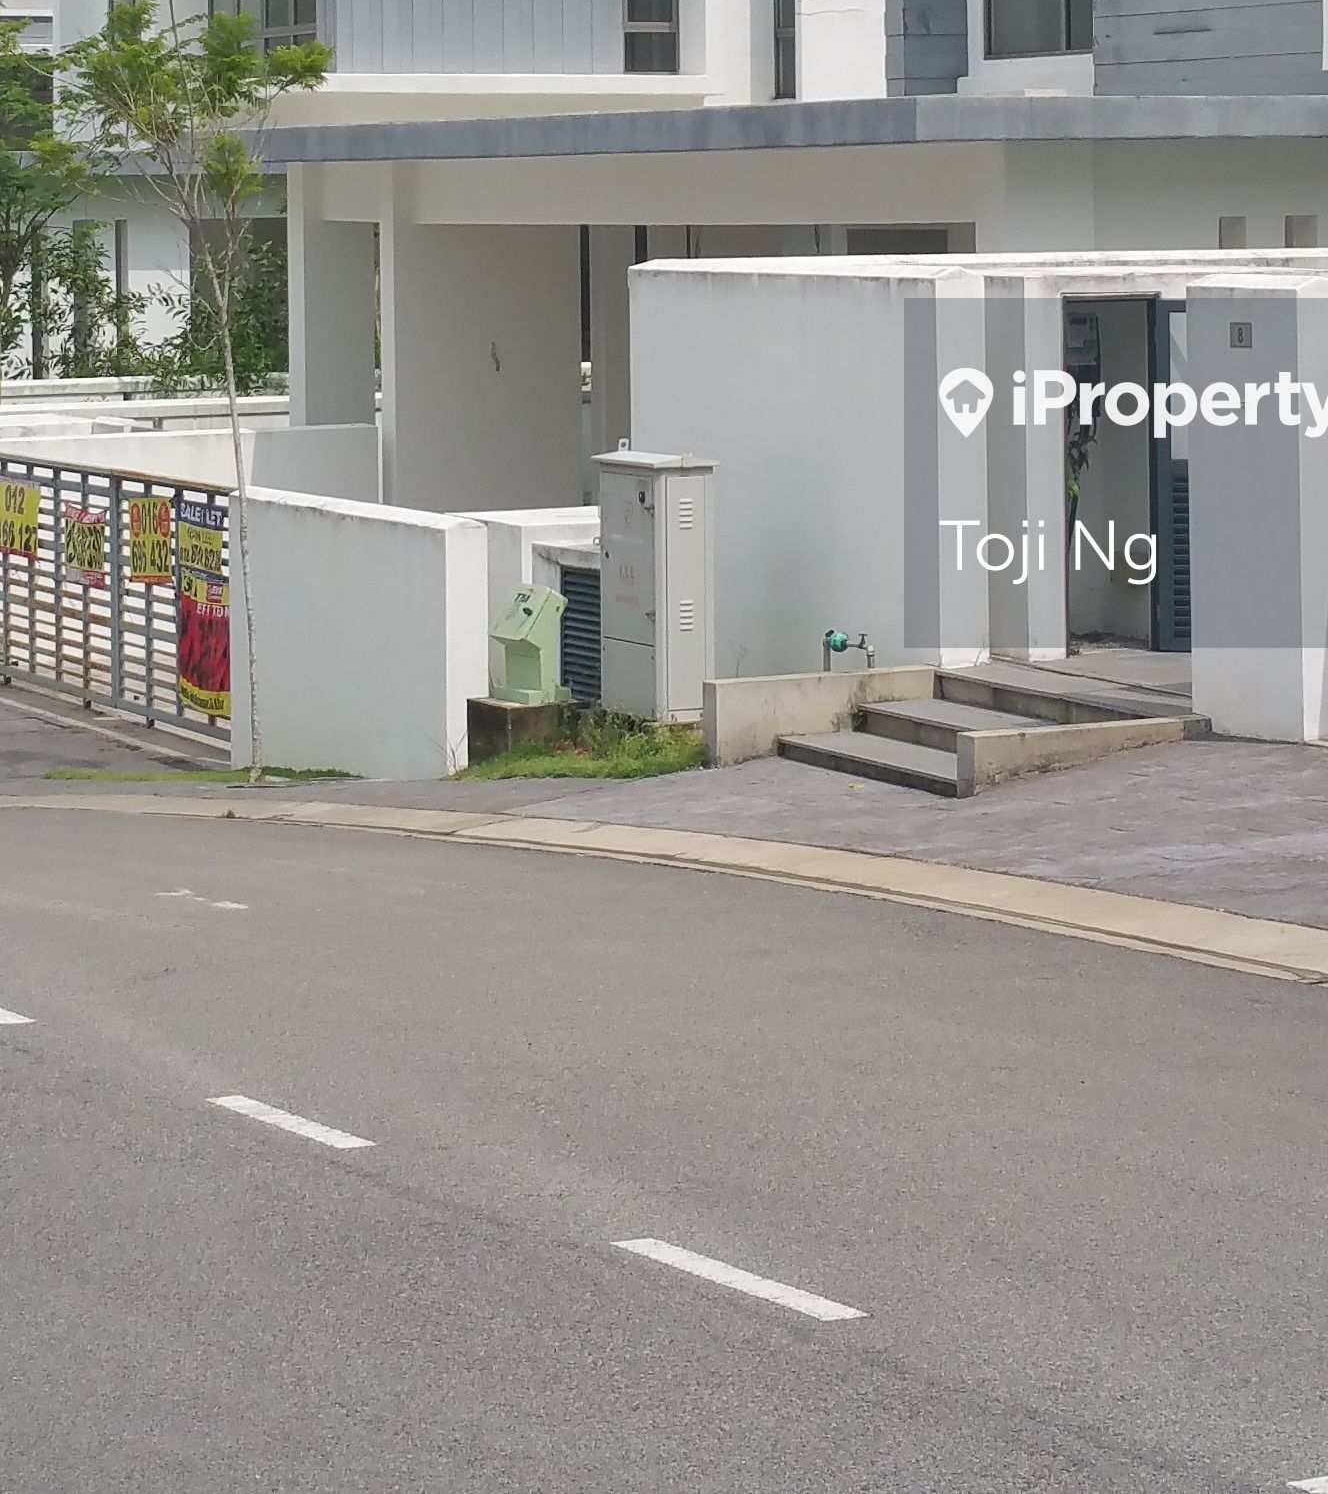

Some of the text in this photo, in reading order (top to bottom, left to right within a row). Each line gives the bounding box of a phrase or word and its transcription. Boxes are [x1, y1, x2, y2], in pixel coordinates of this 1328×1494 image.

[1237, 327, 1244, 344] 8
[5, 485, 25, 515] 012
[150, 540, 170, 573] 432
